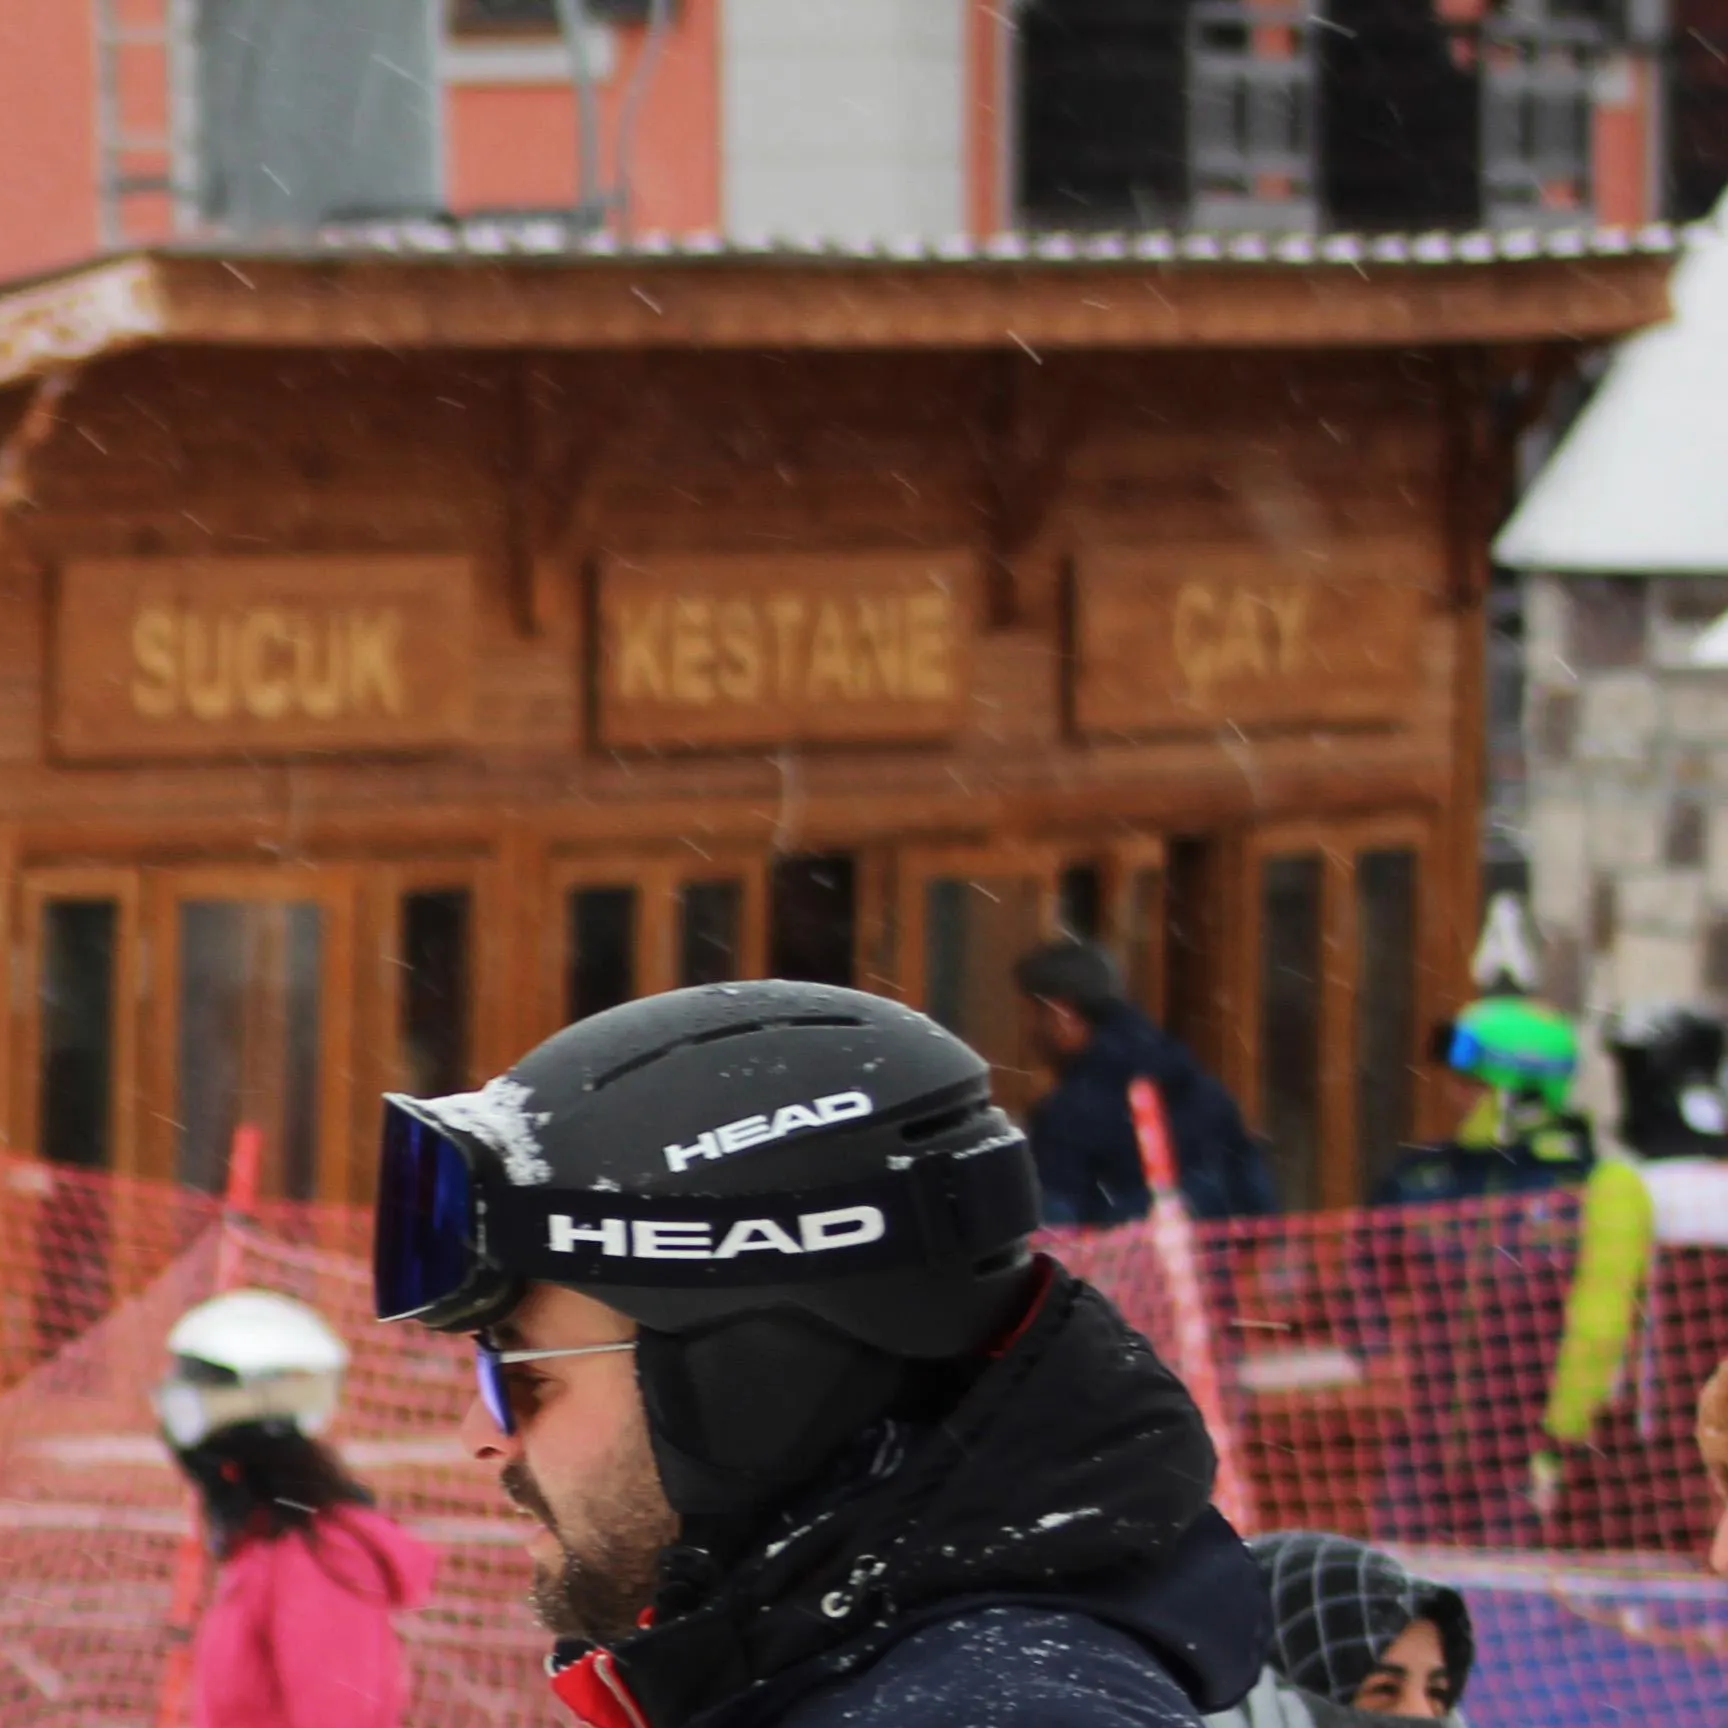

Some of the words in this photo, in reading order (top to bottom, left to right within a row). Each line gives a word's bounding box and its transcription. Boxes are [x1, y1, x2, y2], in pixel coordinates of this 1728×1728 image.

[132, 608, 404, 718] SUCUK
[617, 594, 954, 704] KESTANE
[1173, 582, 1310, 712] ÇAY
[663, 1090, 874, 1172] HEAD
[547, 1205, 886, 1260] HEAD
